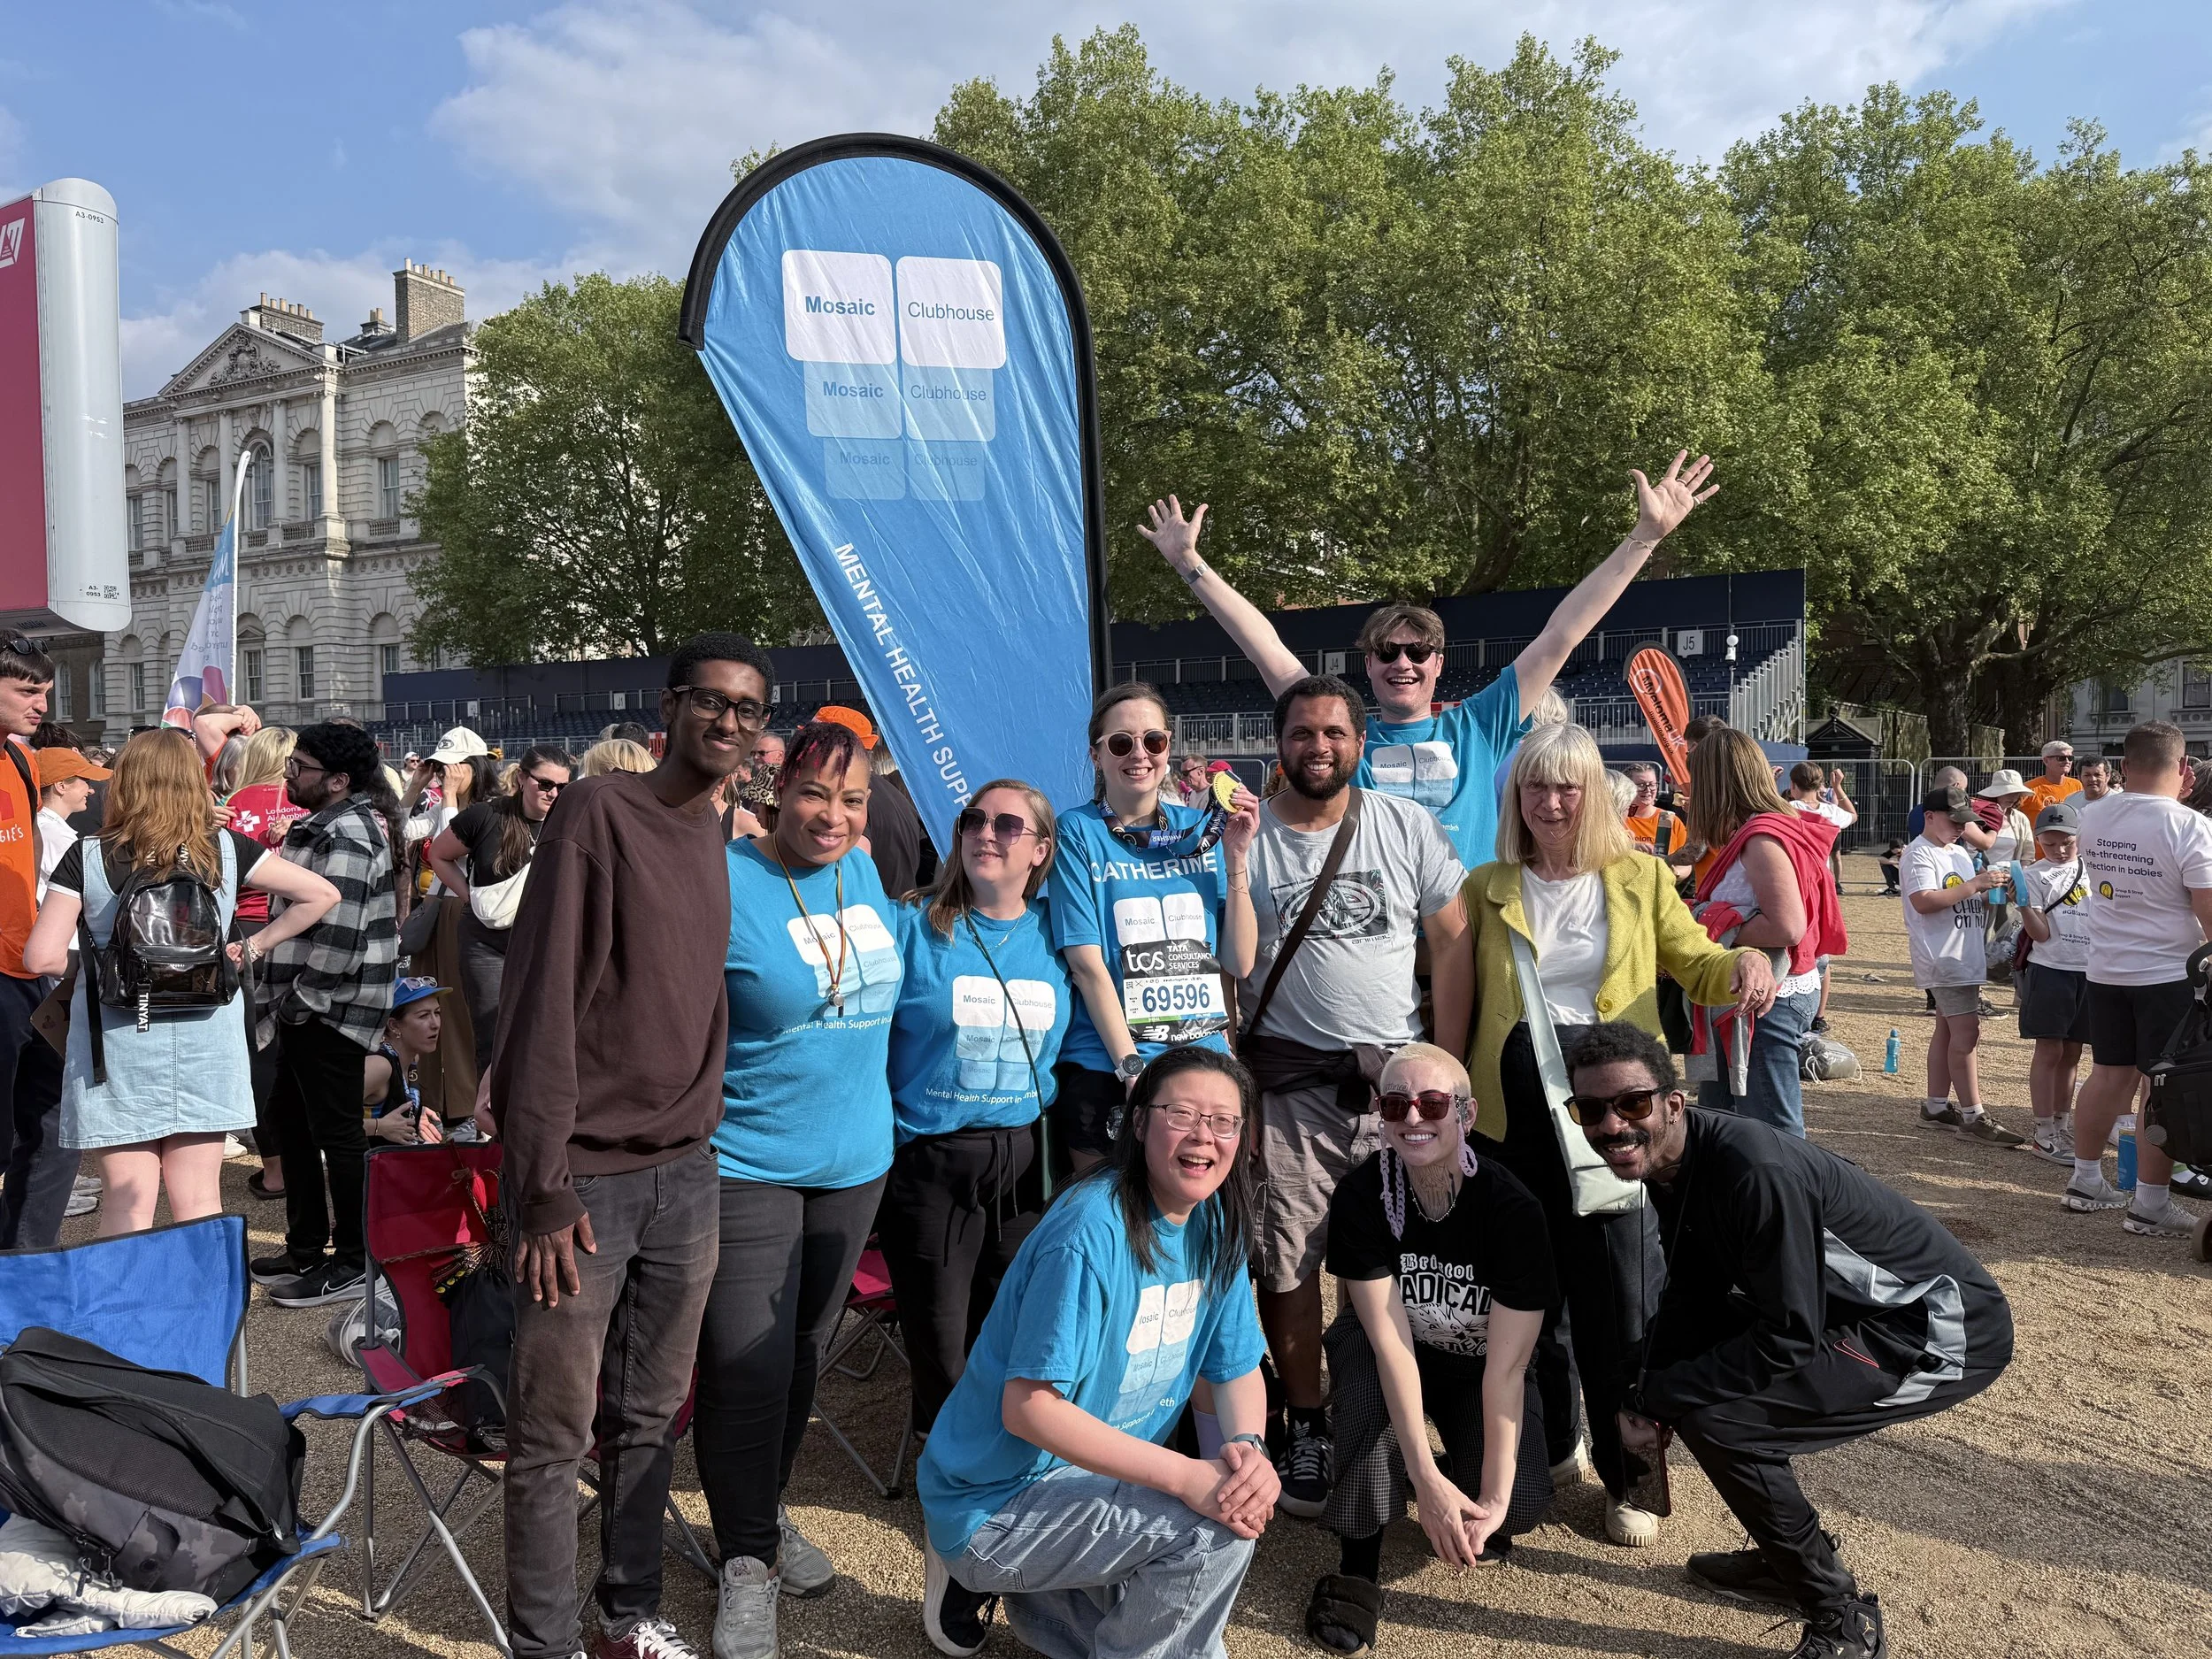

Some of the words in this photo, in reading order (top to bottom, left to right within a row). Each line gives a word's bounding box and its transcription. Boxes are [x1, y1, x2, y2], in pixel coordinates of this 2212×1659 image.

[75, 211, 104, 224] A3-0953
[805, 296, 876, 316] Mosaic
[908, 301, 995, 321] Clubhouse
[822, 380, 884, 398] Mosaic
[910, 384, 987, 401] Clubhouse
[840, 452, 891, 465] Mosaic
[914, 453, 978, 466] Clubhouse
[1683, 636, 1695, 651] J5
[1329, 657, 1340, 671] J4
[834, 542, 894, 646] MENTAL
[885, 647, 944, 744] HEALTH
[933, 746, 974, 808] SUPP
[1642, 674, 1673, 733] Myeloma
[1668, 728, 1686, 752] UK
[2096, 838, 2137, 851] Stopping
[1090, 852, 1218, 884] CATHERINE
[2127, 868, 2163, 878] babies
[1125, 916, 1156, 926] Mosaic
[803, 932, 836, 945] Moaic
[1126, 949, 1165, 972] tcs
[1168, 953, 1212, 962] CONSULTANCY
[1169, 961, 1200, 970] SERVICES
[963, 995, 996, 1005] Mosaic
[1141, 982, 1210, 1013] 69596
[138, 993, 150, 1032] TINYAT
[815, 1019, 846, 1030] Health
[848, 1017, 879, 1031] Support
[966, 1033, 995, 1044] Mosaic
[926, 1087, 953, 1100] Mental
[954, 1092, 980, 1103] Health
[981, 1094, 1013, 1105] Support
[1400, 1272, 1492, 1316] ADICAL
